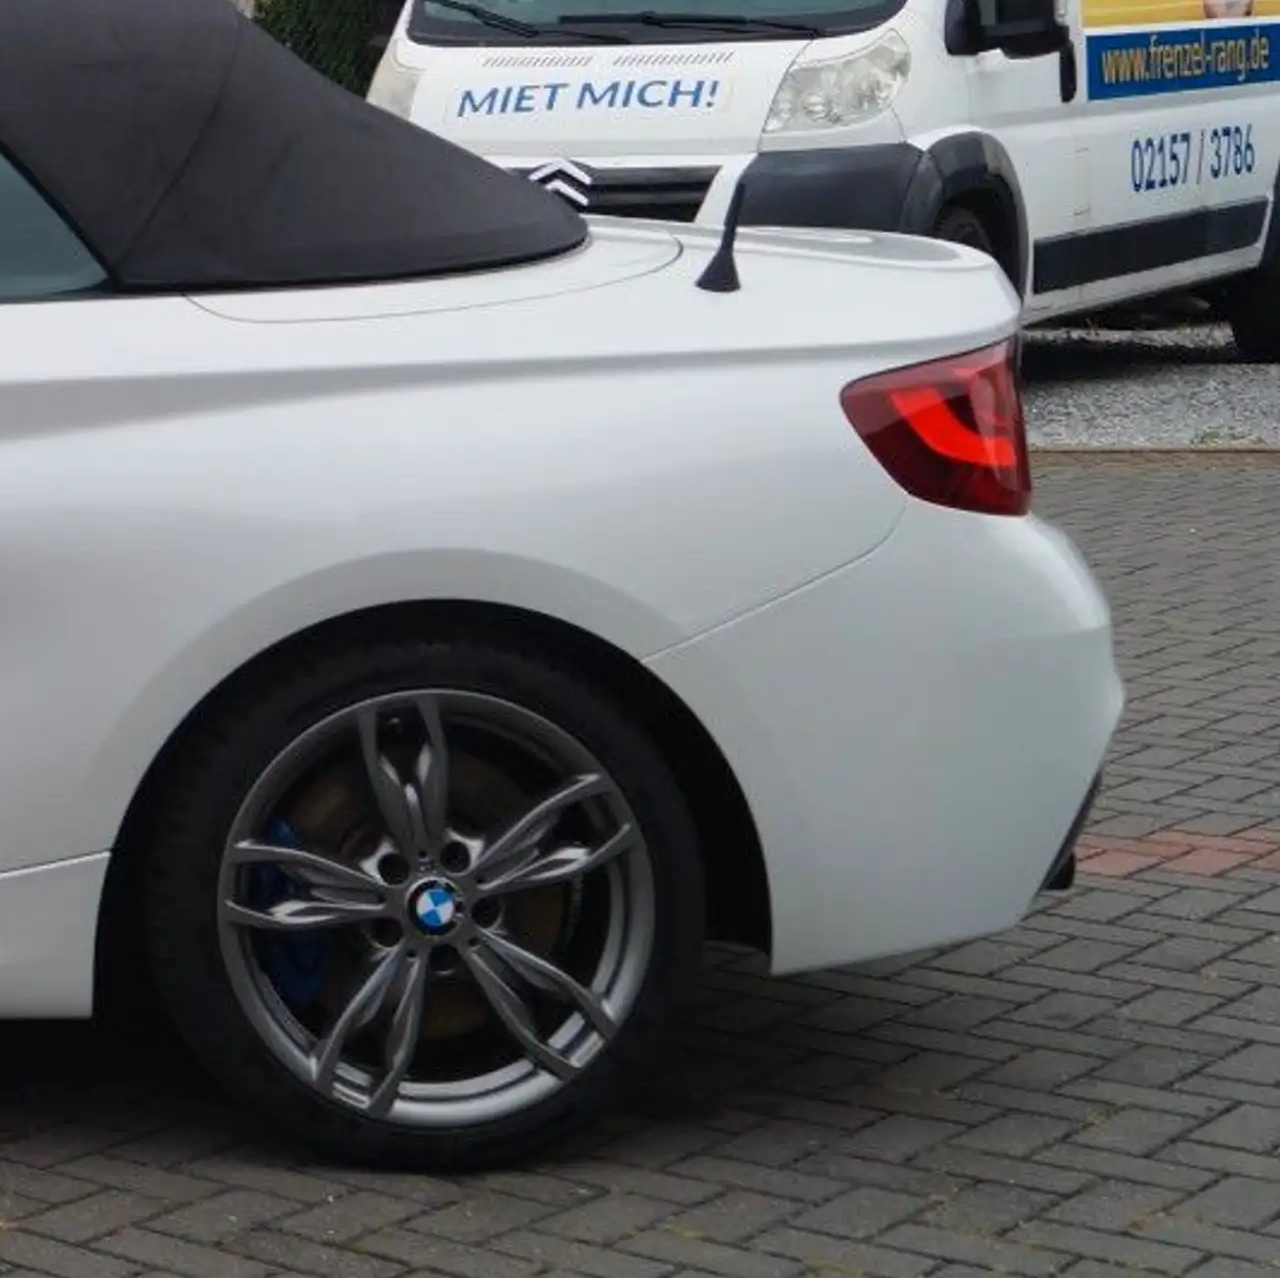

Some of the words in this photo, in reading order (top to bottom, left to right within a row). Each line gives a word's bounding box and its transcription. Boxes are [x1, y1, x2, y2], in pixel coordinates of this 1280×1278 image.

[1101, 27, 1270, 84] www.frenzel-rang.de
[457, 82, 570, 118] MIET
[576, 79, 720, 110] MICH!
[1130, 132, 1190, 192] 02157
[1196, 128, 1206, 186] /
[1209, 124, 1255, 179] 3786
